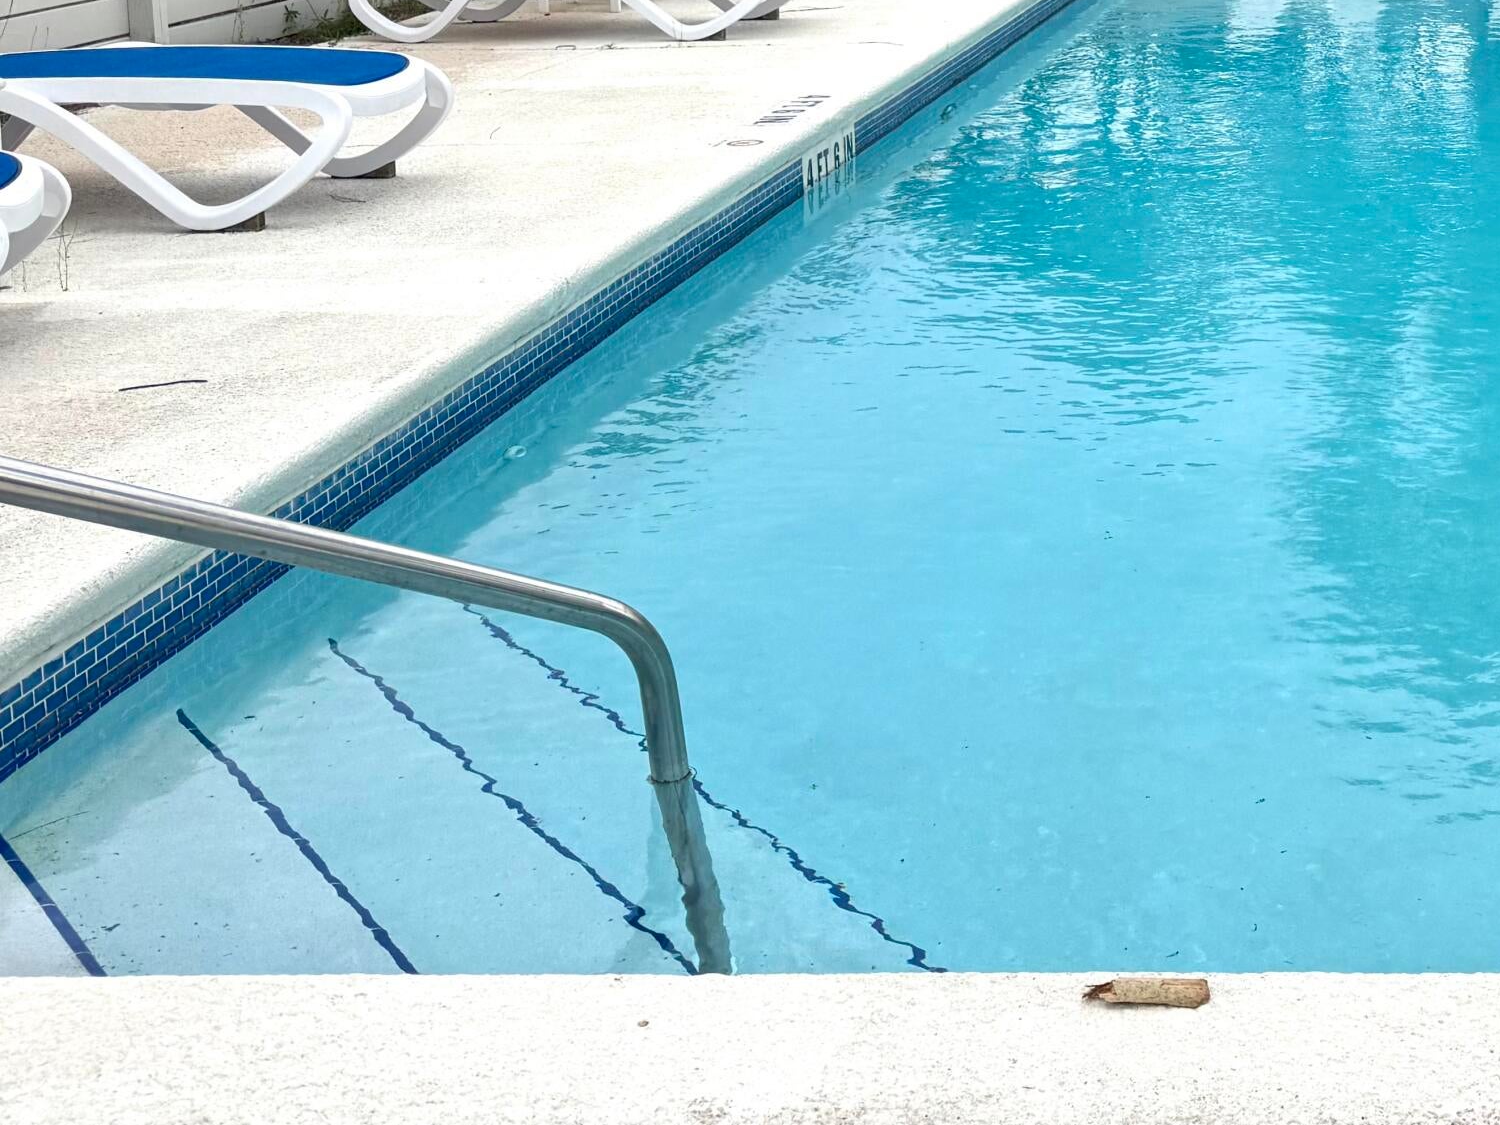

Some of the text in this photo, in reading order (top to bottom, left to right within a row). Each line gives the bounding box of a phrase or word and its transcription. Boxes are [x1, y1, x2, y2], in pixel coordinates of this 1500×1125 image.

[807, 132, 854, 187] 4 FT 6 IN
